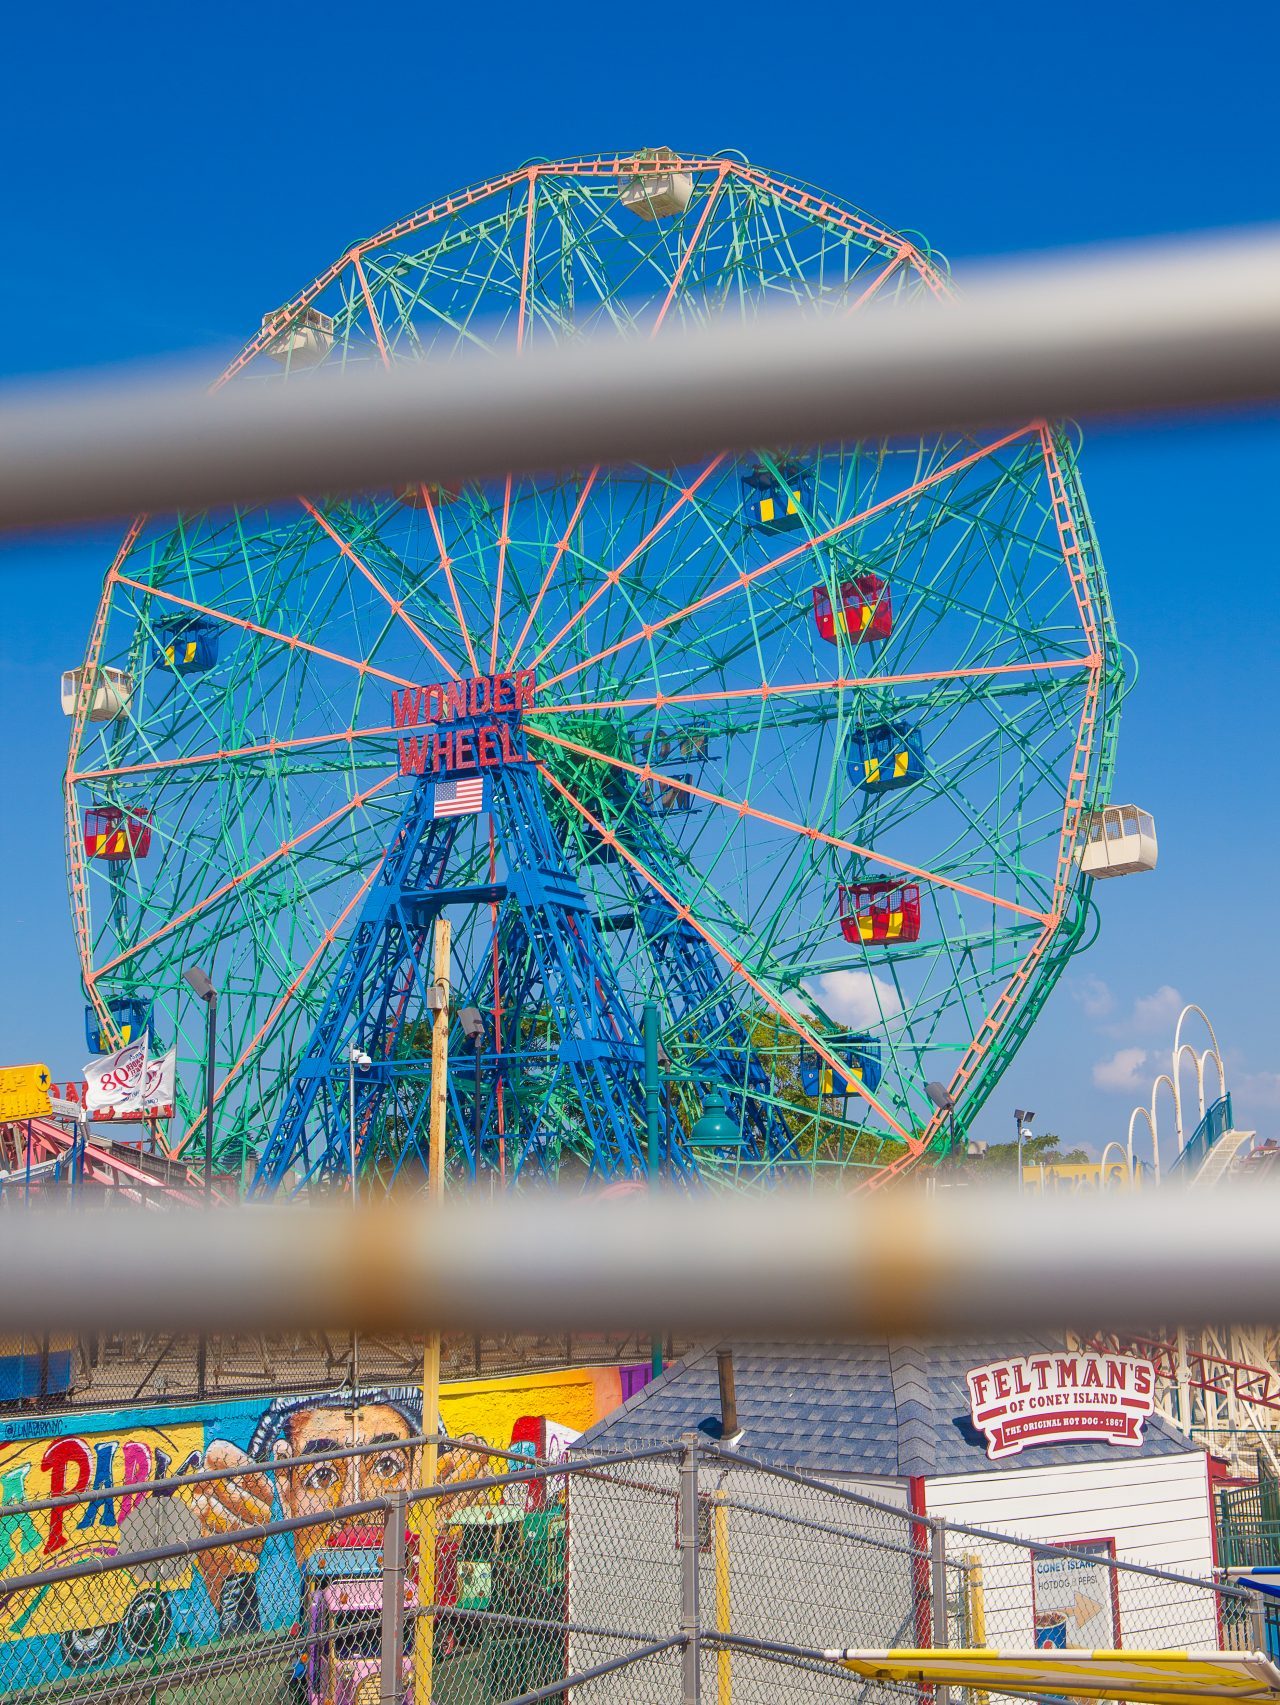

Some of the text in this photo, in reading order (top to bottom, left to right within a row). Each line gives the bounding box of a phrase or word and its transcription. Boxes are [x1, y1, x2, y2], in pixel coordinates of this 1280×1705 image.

[391, 669, 536, 728] WONDER
[397, 723, 523, 776] WHEEL
[971, 1359, 1151, 1407] FELTMAN'S
[1010, 1393, 1118, 1413] OF CONEY ISLAND
[1005, 1426, 1022, 1436] THE
[1023, 1418, 1062, 1431] ORIGINAL
[1063, 1417, 1080, 1425] HOT
[1081, 1417, 1099, 1425] DOG
[1105, 1418, 1124, 1427] 1867
[1037, 1560, 1065, 1574] CONEY
[1038, 1578, 1070, 1590] HOTDOG
[1078, 1575, 1098, 1585] PEPSI
